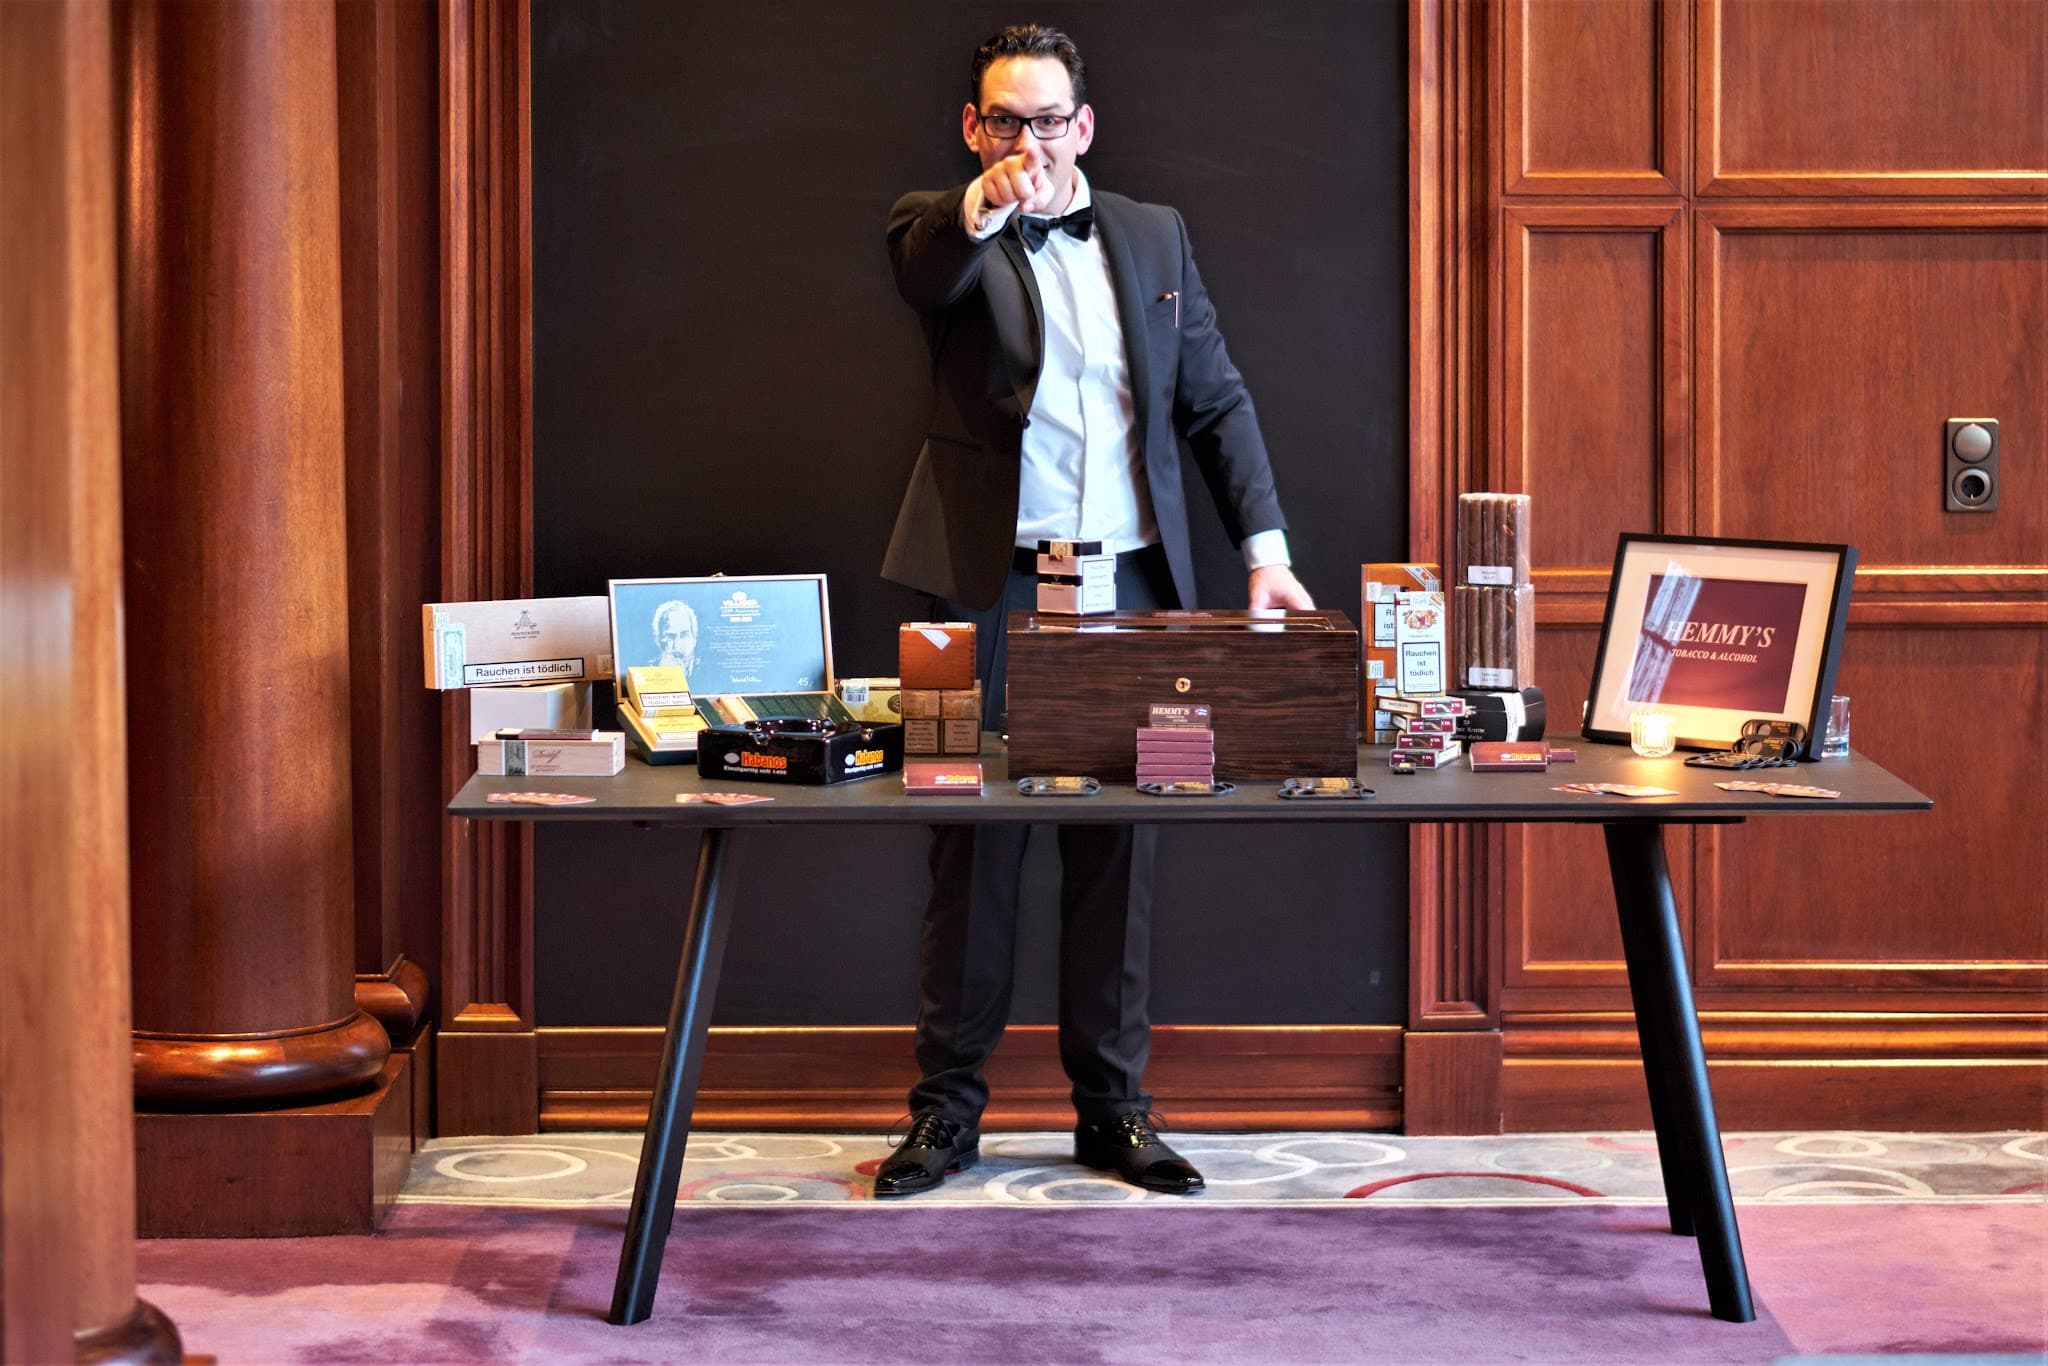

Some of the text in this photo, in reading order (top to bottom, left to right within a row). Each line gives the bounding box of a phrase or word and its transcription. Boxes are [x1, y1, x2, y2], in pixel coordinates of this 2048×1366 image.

[1663, 621, 1776, 648] HEMMY'S
[1671, 648, 1758, 663] TOBACCO & ALCOHOL
[476, 663, 572, 677] Rauchen ist tödlich
[741, 751, 787, 769] Habanos
